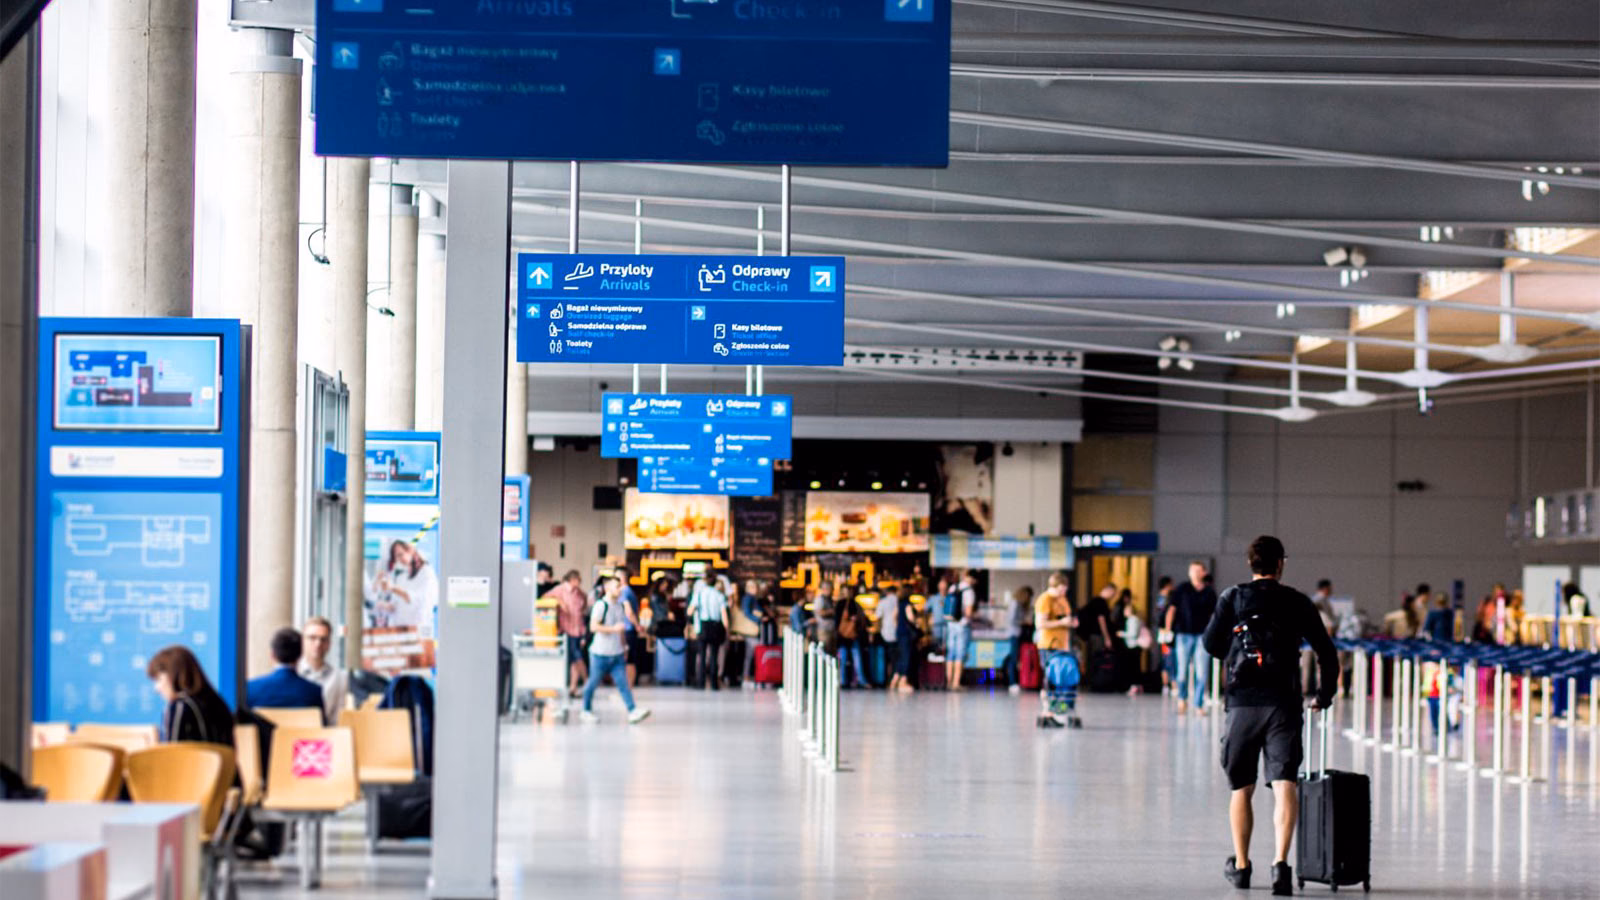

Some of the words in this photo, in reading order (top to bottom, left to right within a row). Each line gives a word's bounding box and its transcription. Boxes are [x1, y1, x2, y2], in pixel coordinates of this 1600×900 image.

[733, 0, 841, 20] Checkin
[600, 263, 654, 278] Przyloty
[732, 264, 791, 279] Odprawy
[600, 279, 650, 291] Arrivals
[732, 280, 788, 292] Check-in
